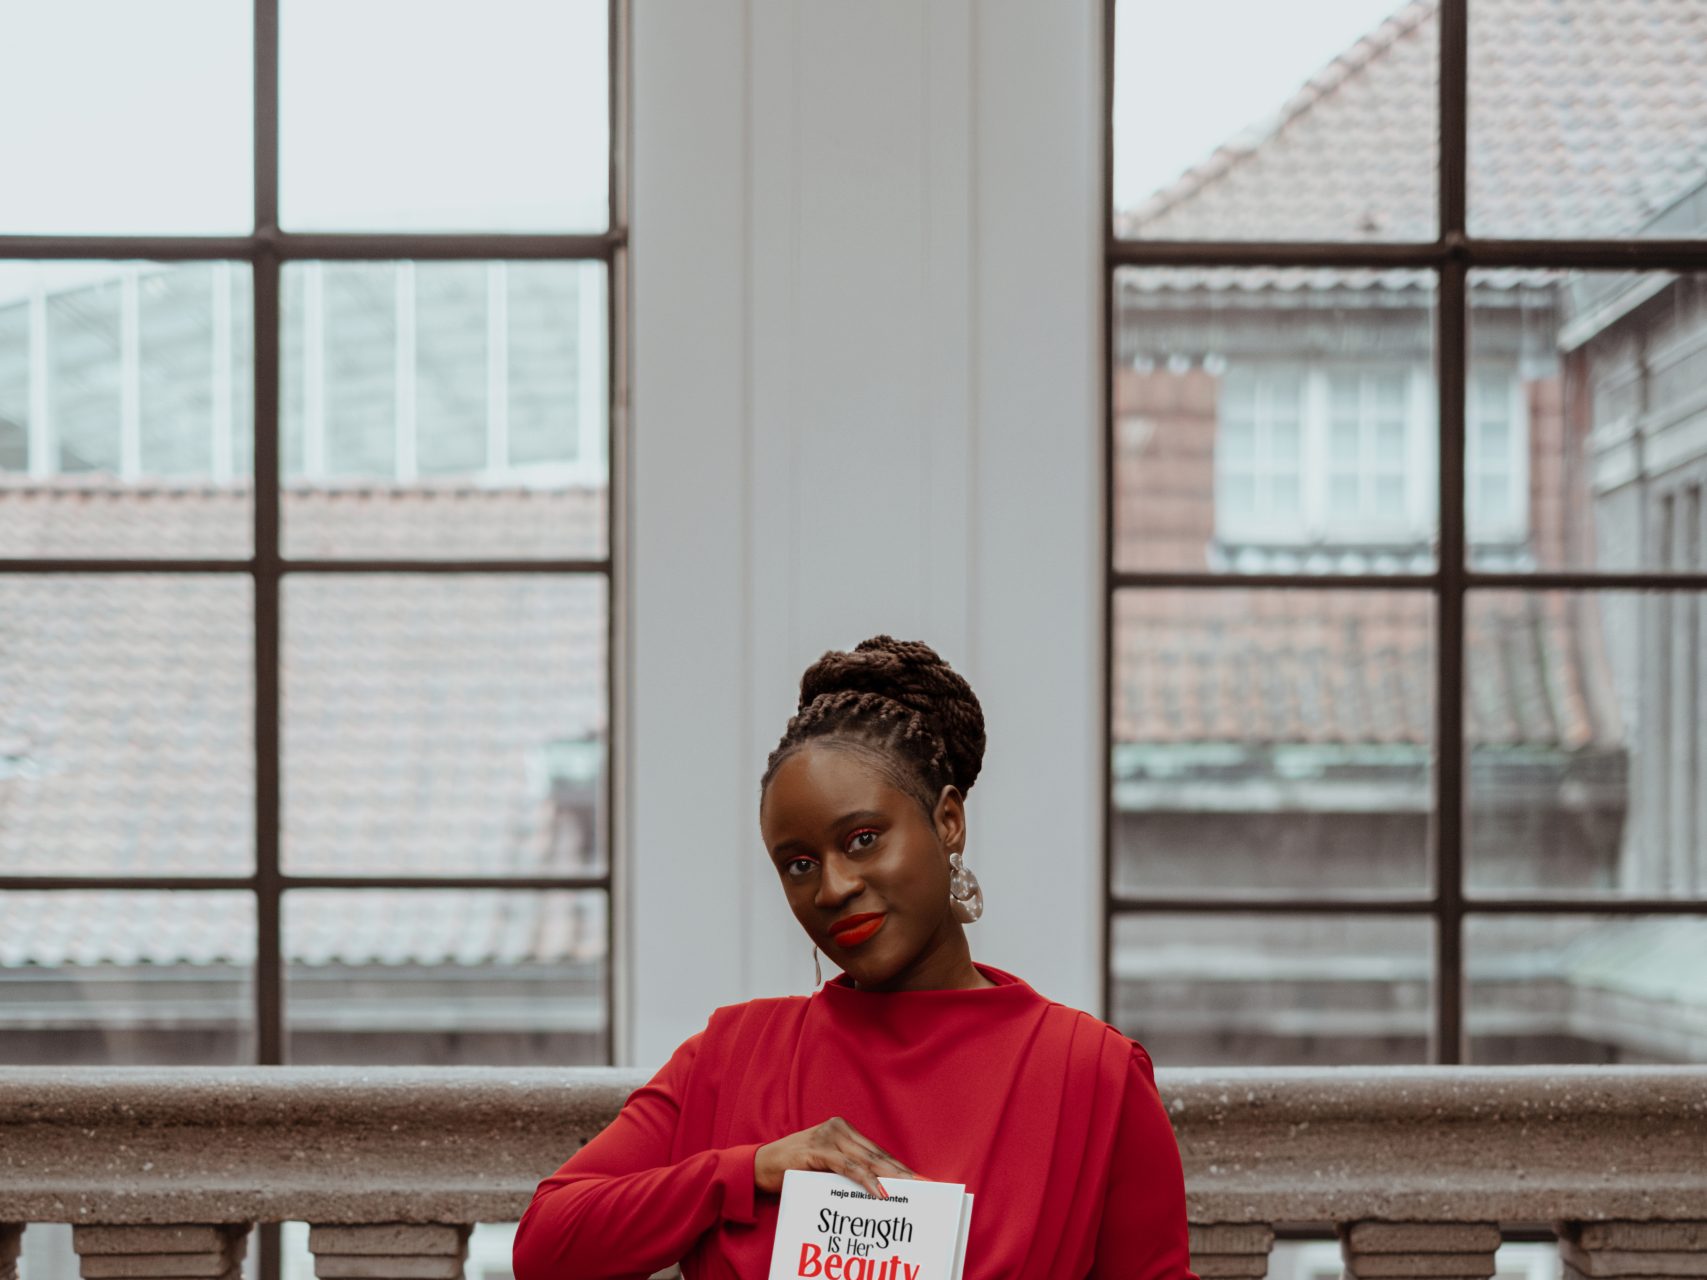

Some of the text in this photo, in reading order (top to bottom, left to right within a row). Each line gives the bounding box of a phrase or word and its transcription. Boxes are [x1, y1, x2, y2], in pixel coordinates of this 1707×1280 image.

[830, 1188, 849, 1199] Haja
[817, 1207, 913, 1249] Strength
[846, 1238, 875, 1257] Her
